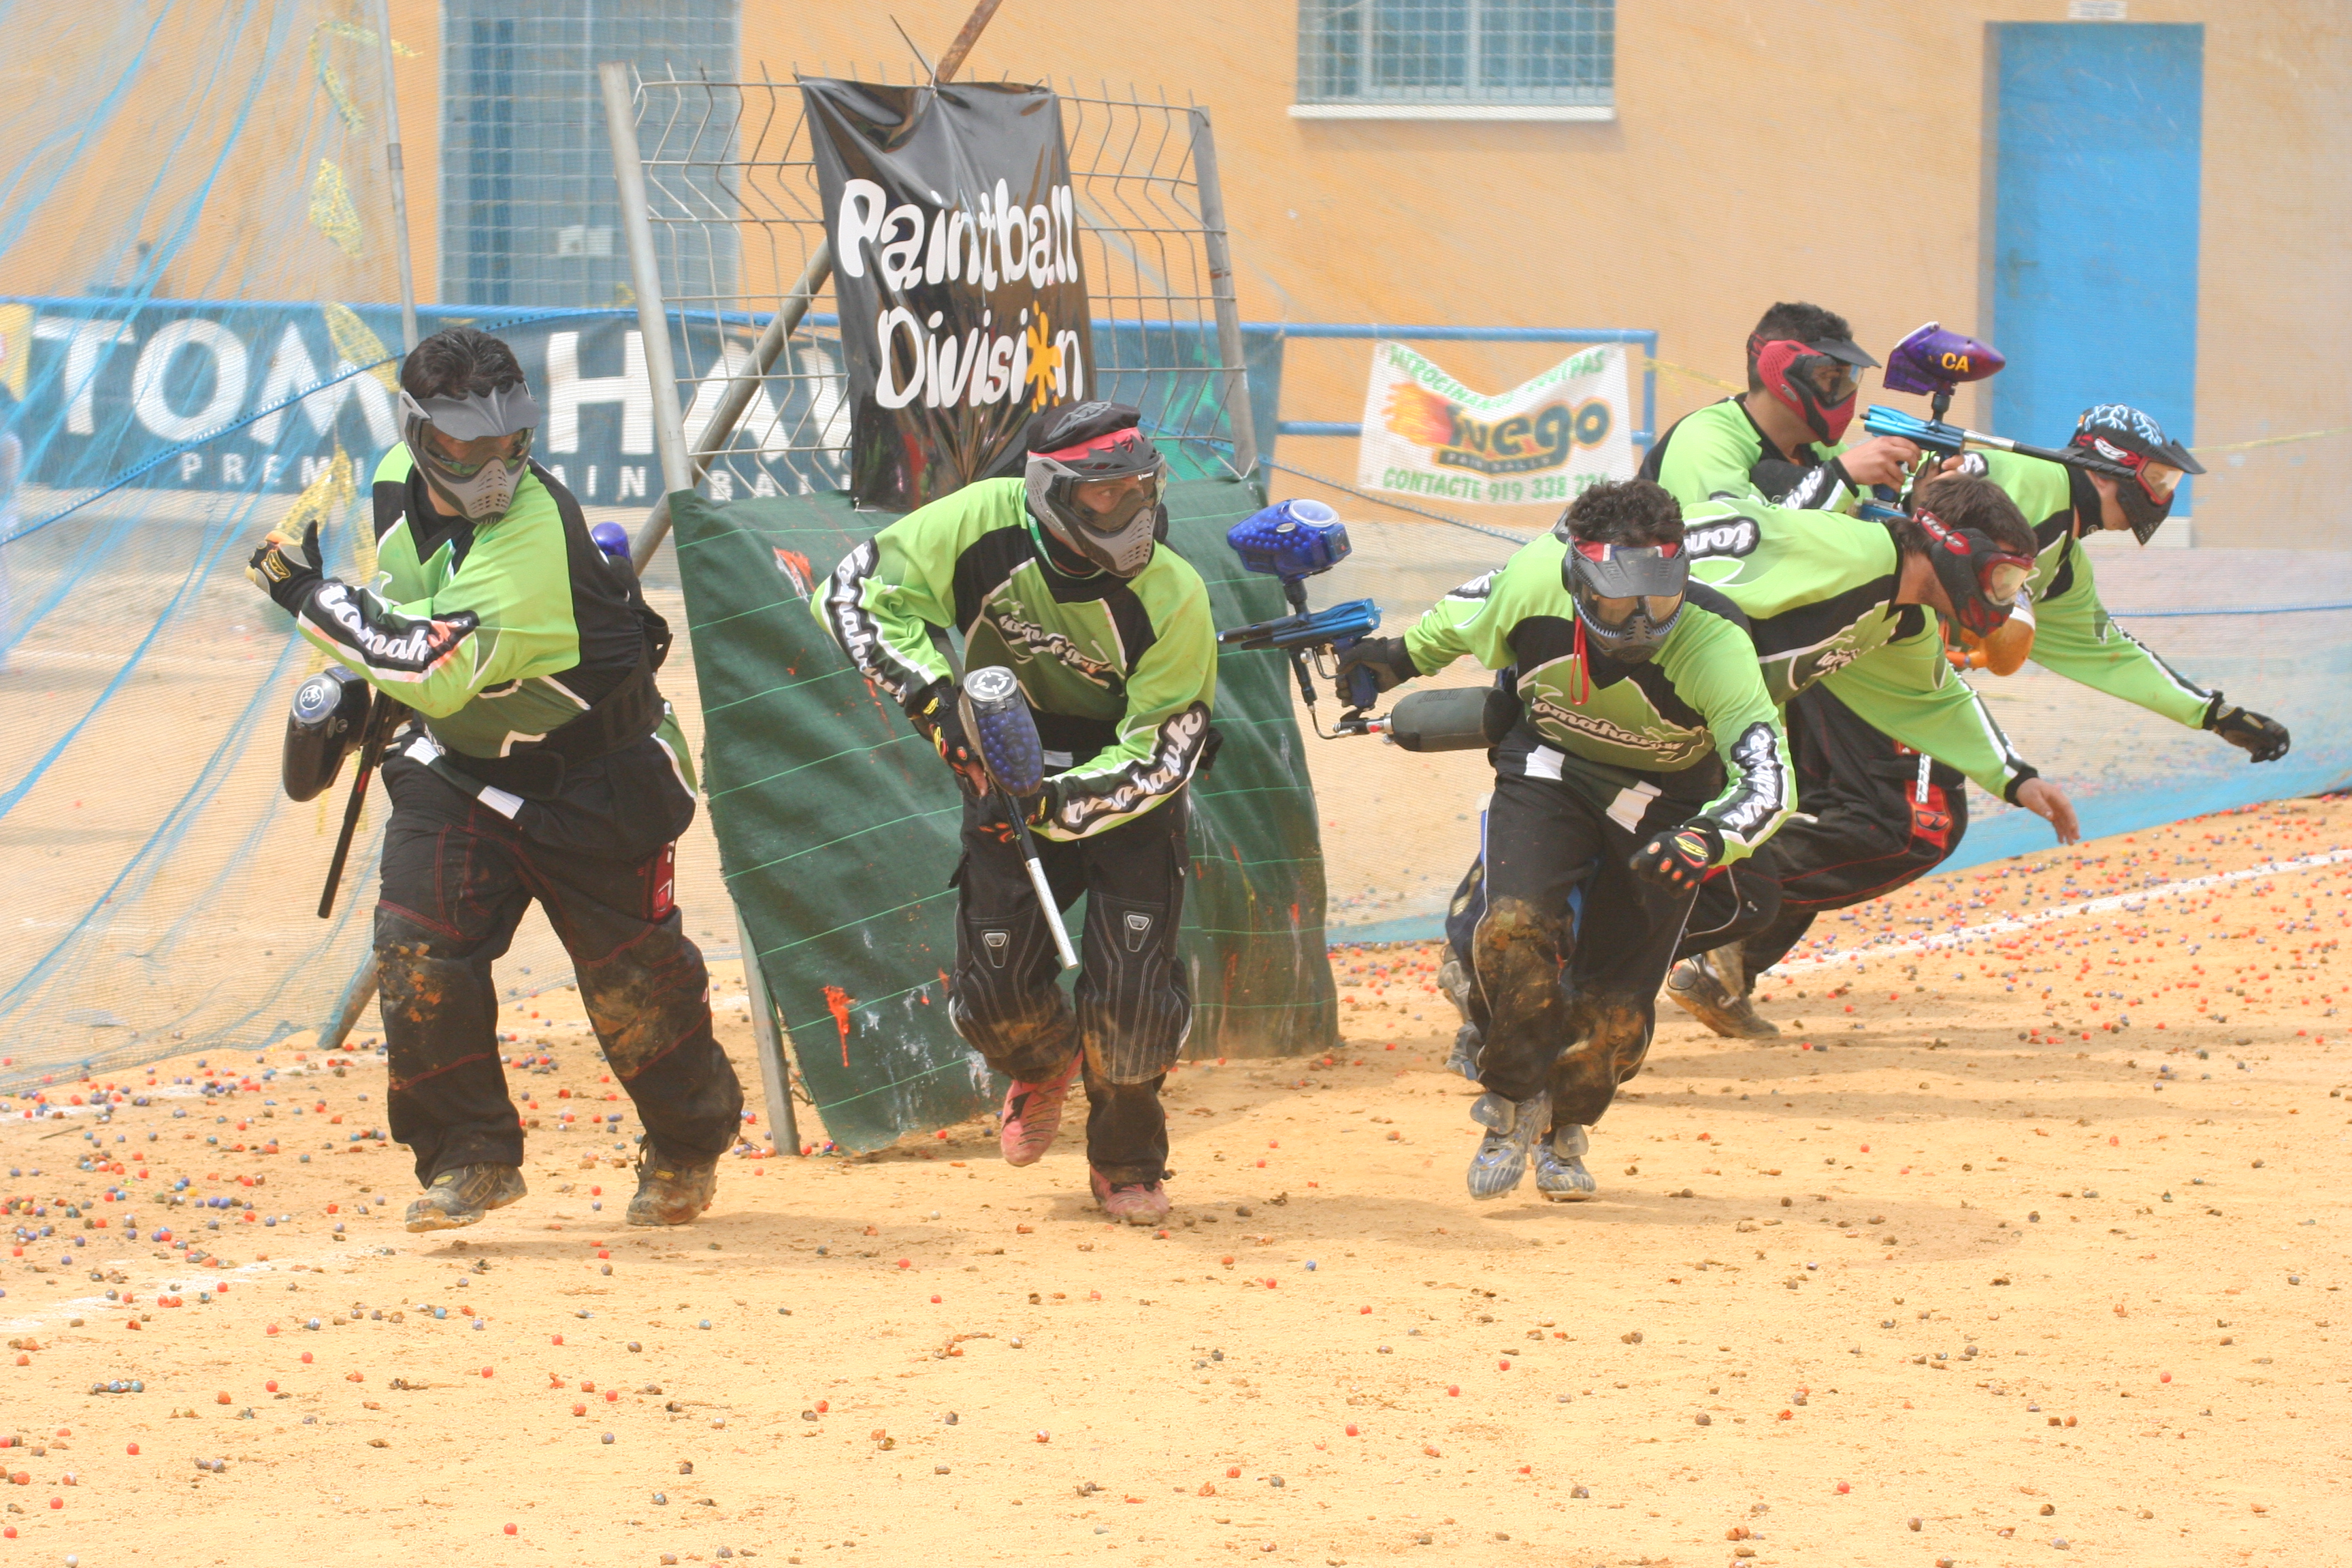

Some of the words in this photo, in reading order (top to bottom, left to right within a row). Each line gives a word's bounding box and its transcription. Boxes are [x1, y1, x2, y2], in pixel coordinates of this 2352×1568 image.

[838, 178, 1079, 292] Paintball
[876, 304, 1083, 410] Divisin
[1941, 352, 1970, 373] CA
[1383, 466, 1482, 500] CONTACTE
[1488, 481, 1524, 501] 919
[1531, 475, 1567, 500] 338
